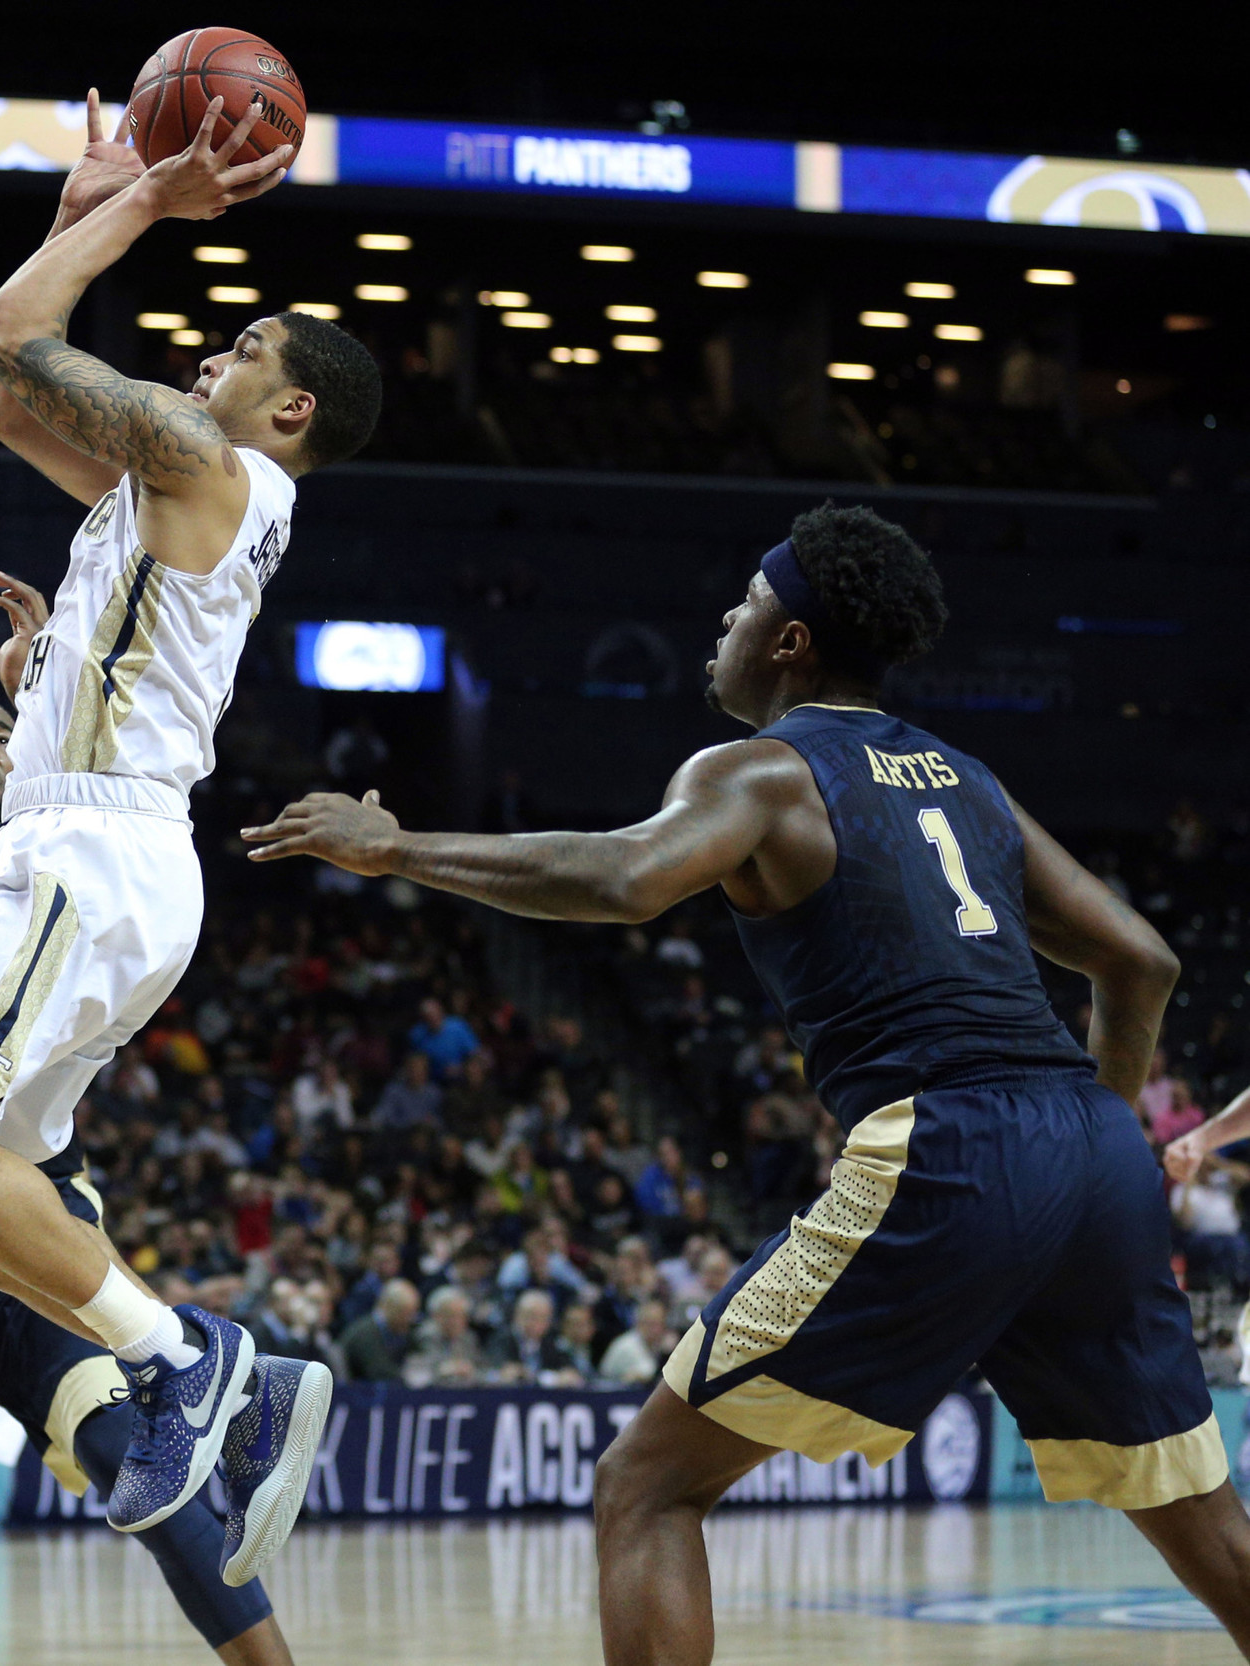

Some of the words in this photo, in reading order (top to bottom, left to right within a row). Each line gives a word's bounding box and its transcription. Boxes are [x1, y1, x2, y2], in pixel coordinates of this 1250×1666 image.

[445, 132, 510, 181] PITT
[513, 135, 692, 194] PANTHERS
[863, 744, 960, 790] ARTIS
[917, 807, 998, 936] 1
[364, 1404, 478, 1513] LIFE
[486, 1402, 596, 1508] ACC
